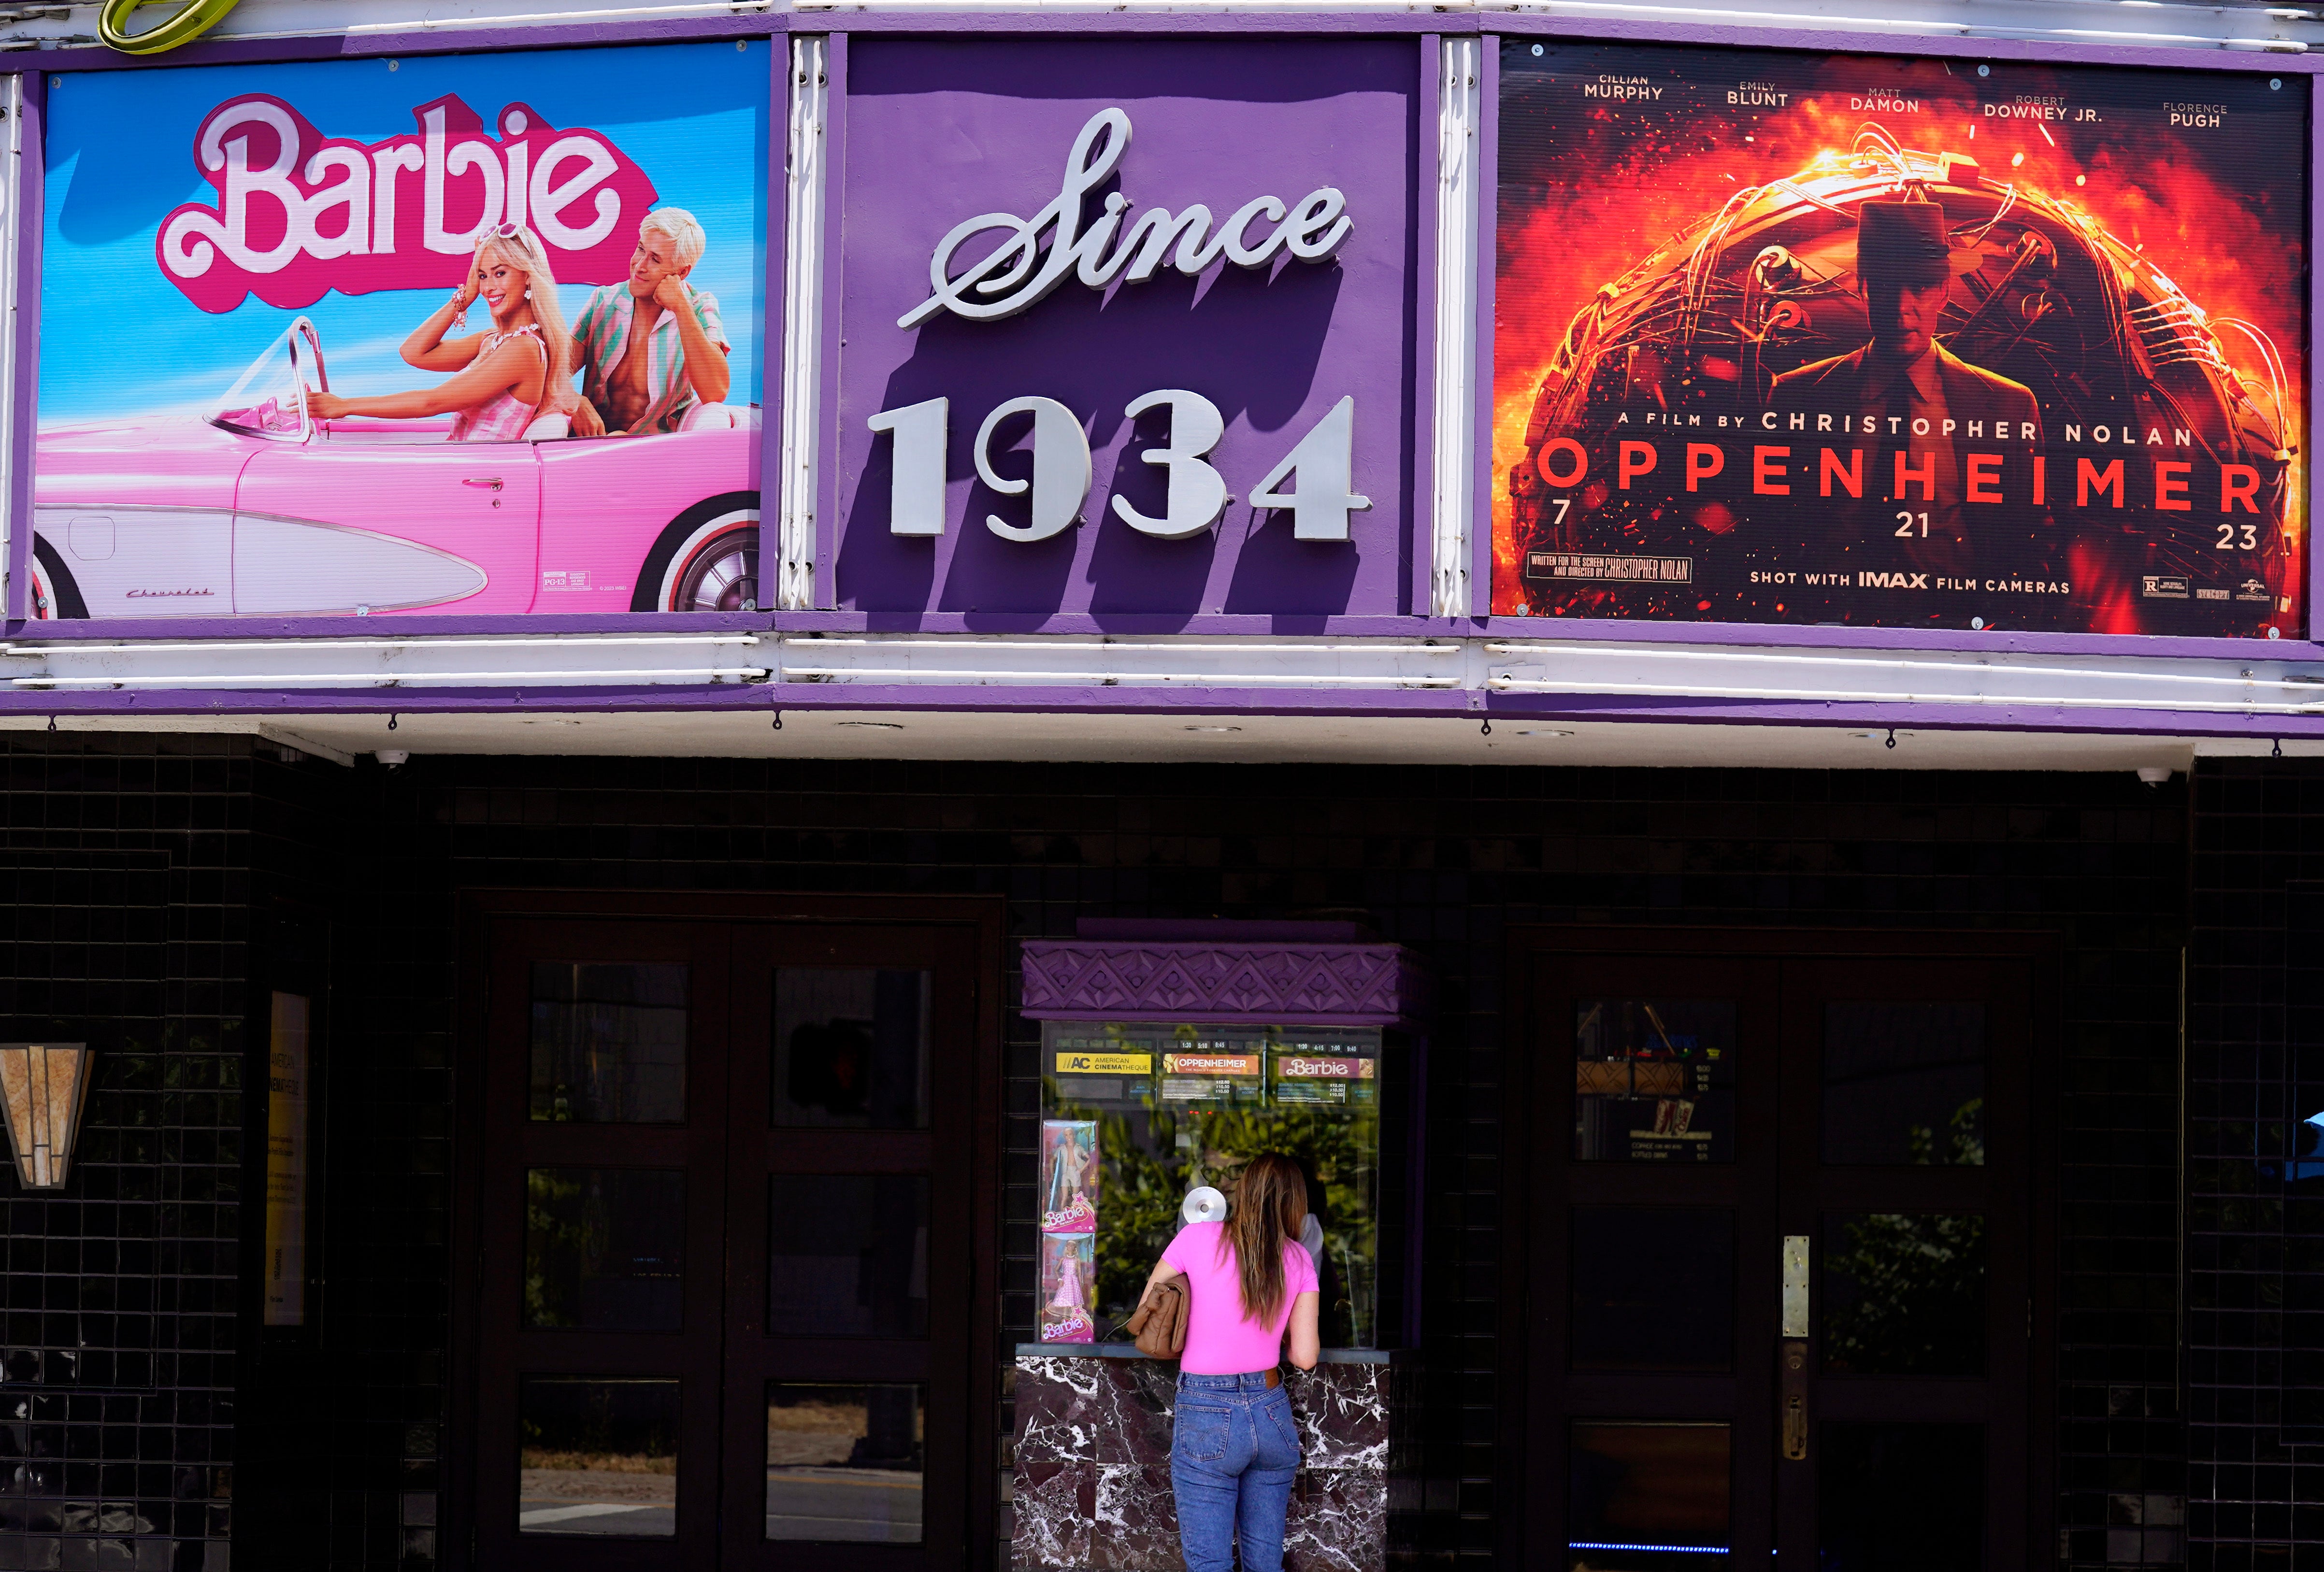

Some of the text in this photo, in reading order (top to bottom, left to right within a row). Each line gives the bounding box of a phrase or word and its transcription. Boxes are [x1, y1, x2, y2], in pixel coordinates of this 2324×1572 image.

[1599, 74, 1648, 85] CILLIAN
[1740, 81, 1775, 91] EMILY
[1585, 84, 1663, 100] MURPHY
[1727, 91, 1788, 106] BLUNT
[1868, 87, 1901, 98] MATT
[1851, 98, 1919, 113] DAMON
[2016, 95, 2065, 106] ROBERT
[2163, 102, 2227, 114] FLORENCE
[1984, 104, 2103, 122] DOWNEY JR.
[2170, 113, 2220, 128] PUGH
[162, 100, 621, 279] Barbie
[896, 107, 1354, 331] Since
[1618, 412, 2191, 446] A FILM BY CHRISTOPHER NOLAN
[867, 389, 1374, 542] 1934
[1537, 437, 2261, 514] OPPENHEIMER
[1552, 499, 2257, 550] 7 21 23
[1531, 555, 1605, 568] WRITTEN FOR THE SCREEN
[1605, 557, 1688, 580] CHRISTOPHER NOLAN
[1554, 566, 1604, 577] AND DIRECTED BY
[1750, 571, 2070, 594] SHOT WITH IMAX FILM CAMERAS
[2144, 581, 2158, 592] R
[1179, 1058, 1246, 1068] OPPENHEIMER
[1286, 1058, 1348, 1075] Barbie
[1045, 1206, 1084, 1228] Barbie
[1043, 1318, 1083, 1340] Barbie
